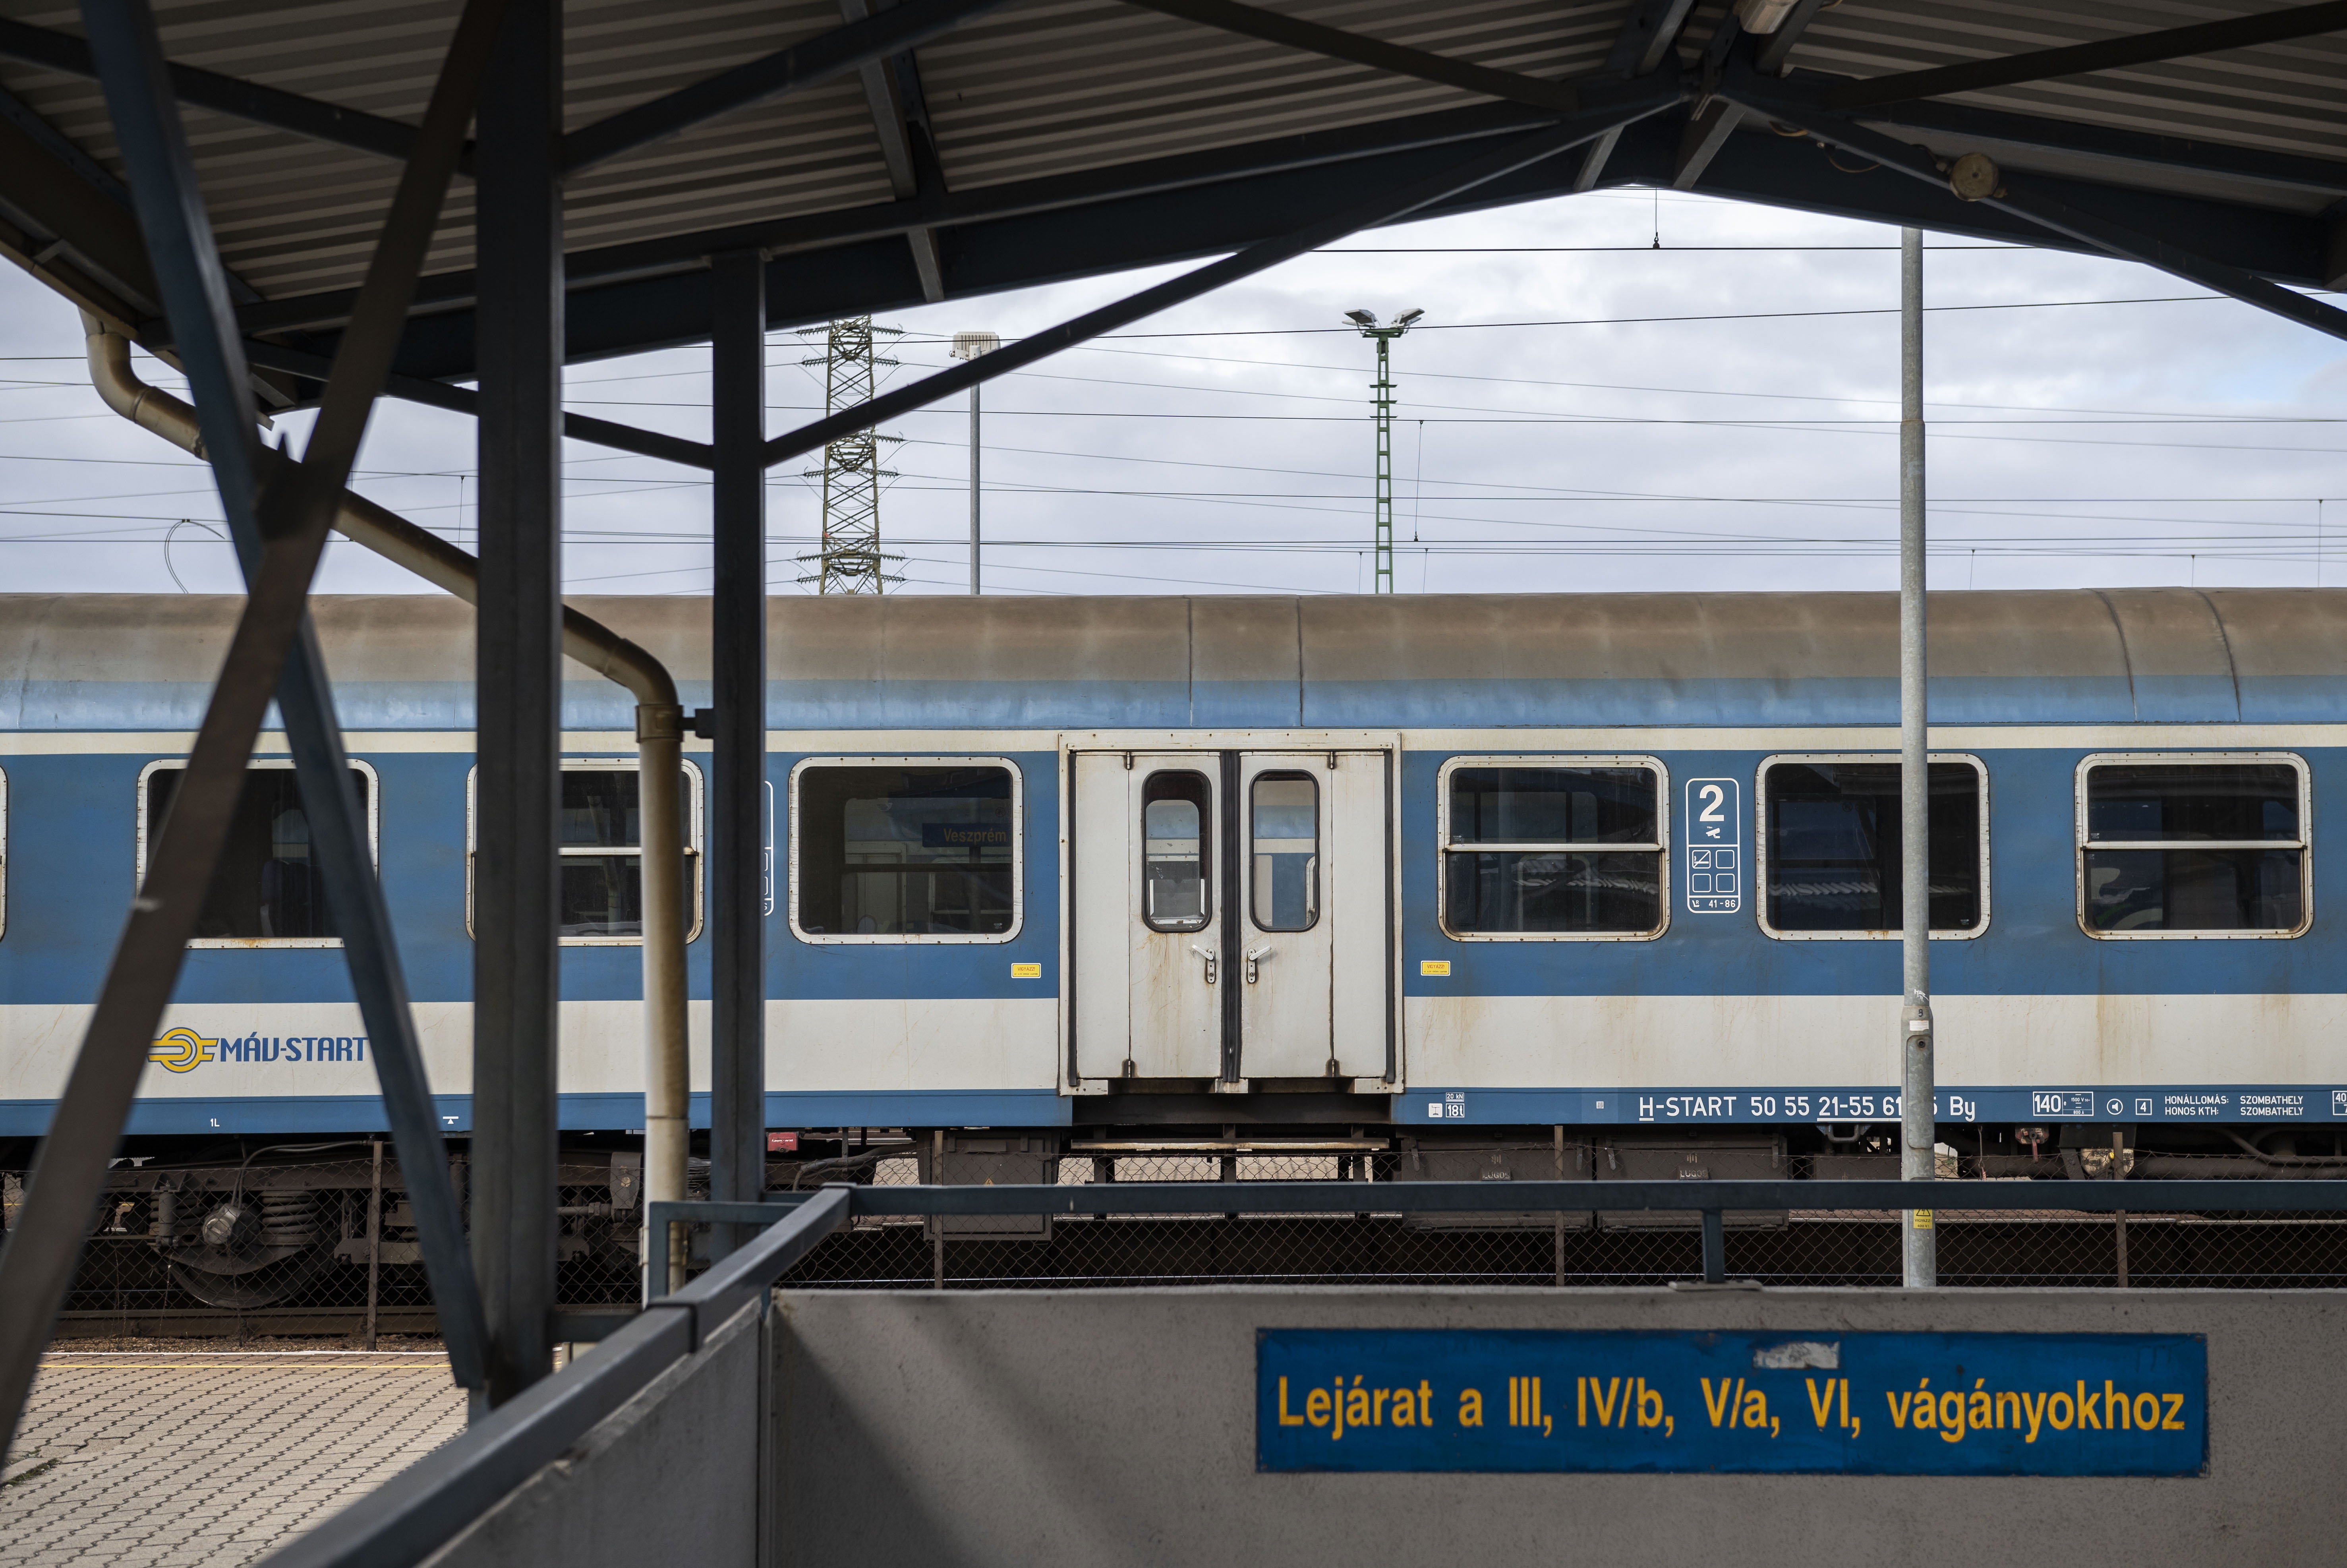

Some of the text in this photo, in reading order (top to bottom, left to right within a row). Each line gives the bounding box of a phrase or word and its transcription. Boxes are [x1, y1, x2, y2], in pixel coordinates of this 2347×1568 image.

[1699, 785, 1724, 821] 2
[943, 828, 1006, 845] Veszprém
[220, 1032, 369, 1062] MÁV-START
[2034, 1094, 2061, 1112] 140
[2140, 1102, 2146, 1112] 4
[2165, 1094, 2303, 1104] HONÁLLOMÁS: SZOMBATHELY
[1448, 1104, 1463, 1116] 18t
[1639, 1096, 1736, 1117] H-START
[1751, 1096, 1775, 1116] 50
[1785, 1096, 1809, 1116] 55
[1819, 1096, 1874, 1116] 21-55
[1951, 1096, 1975, 1122] By
[2165, 1106, 2303, 1116] HONOS KTH: SZOMBATHELY
[210, 1118, 220, 1127] 1L
[1279, 1375, 2185, 1443] Lejárat a III, IV/b, V/a, VI, vágányokhoz
